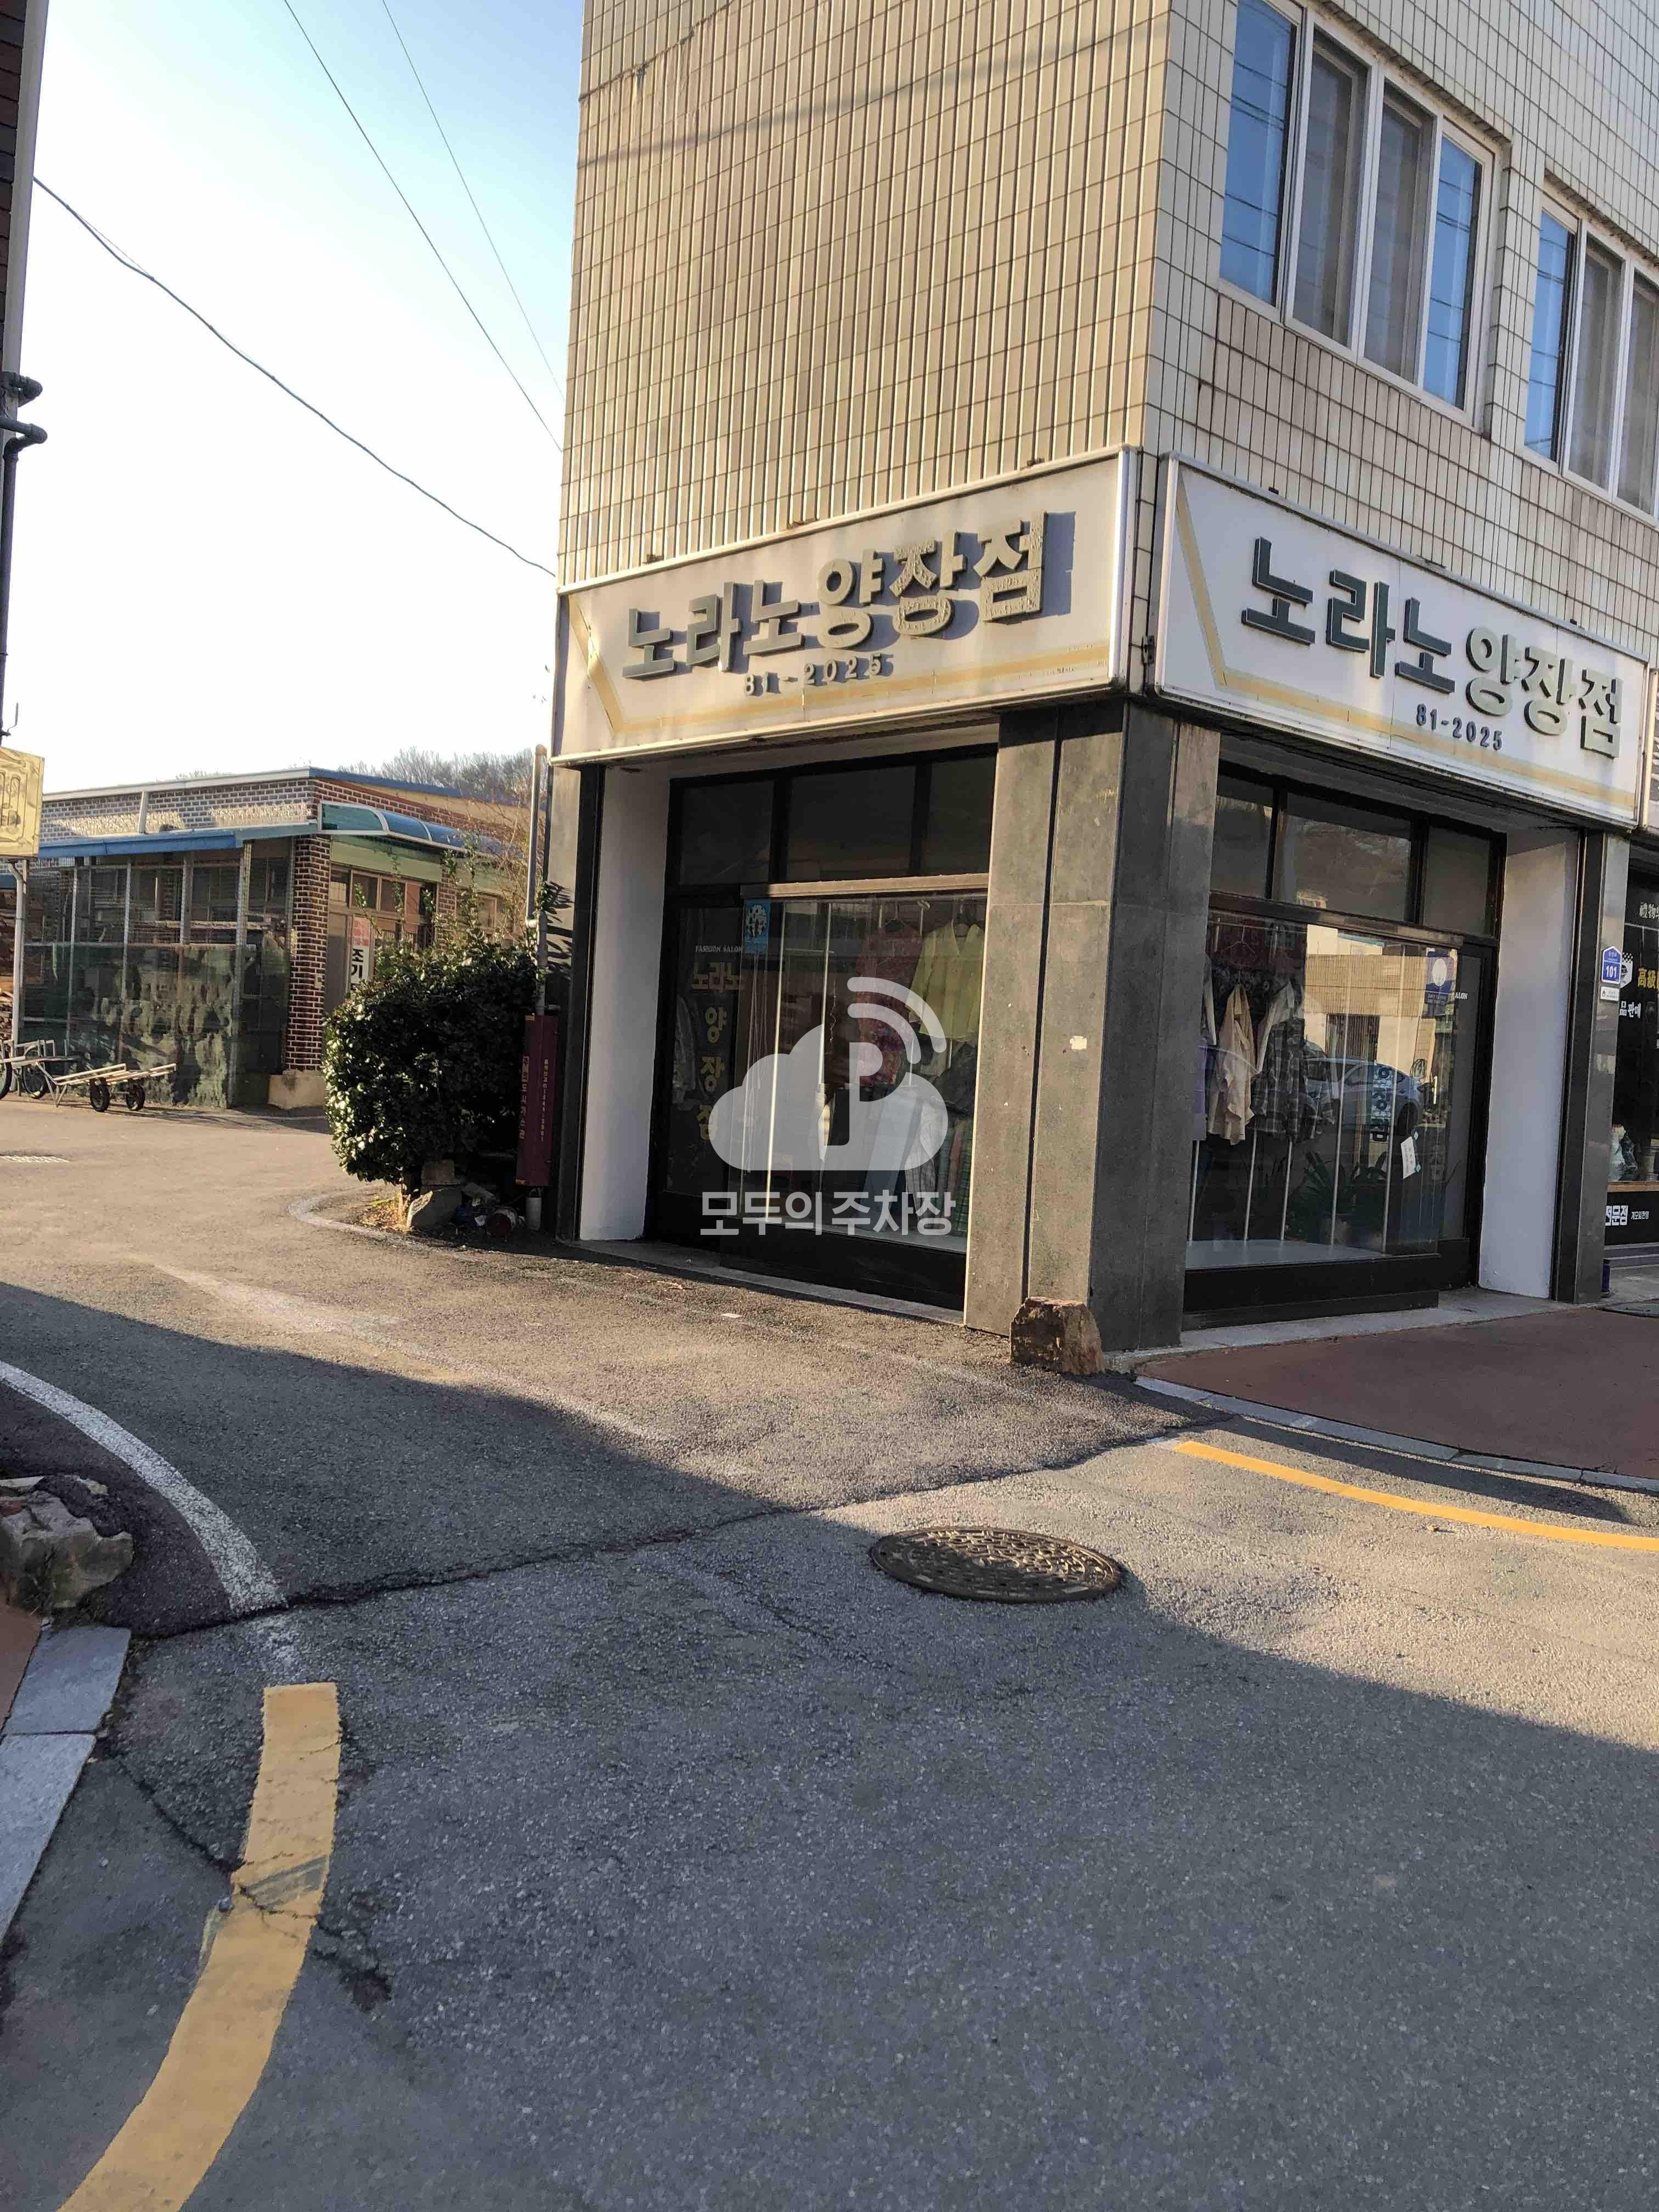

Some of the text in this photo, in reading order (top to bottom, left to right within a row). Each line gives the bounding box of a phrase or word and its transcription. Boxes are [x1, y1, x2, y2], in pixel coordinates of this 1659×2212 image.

[622, 511, 1047, 680] 노라노양장점
[1242, 537, 1623, 759] 노라노양장점
[746, 653, 882, 696] 81-2025
[1416, 703, 1503, 751] 81-2025
[1606, 965, 1617, 979] 101
